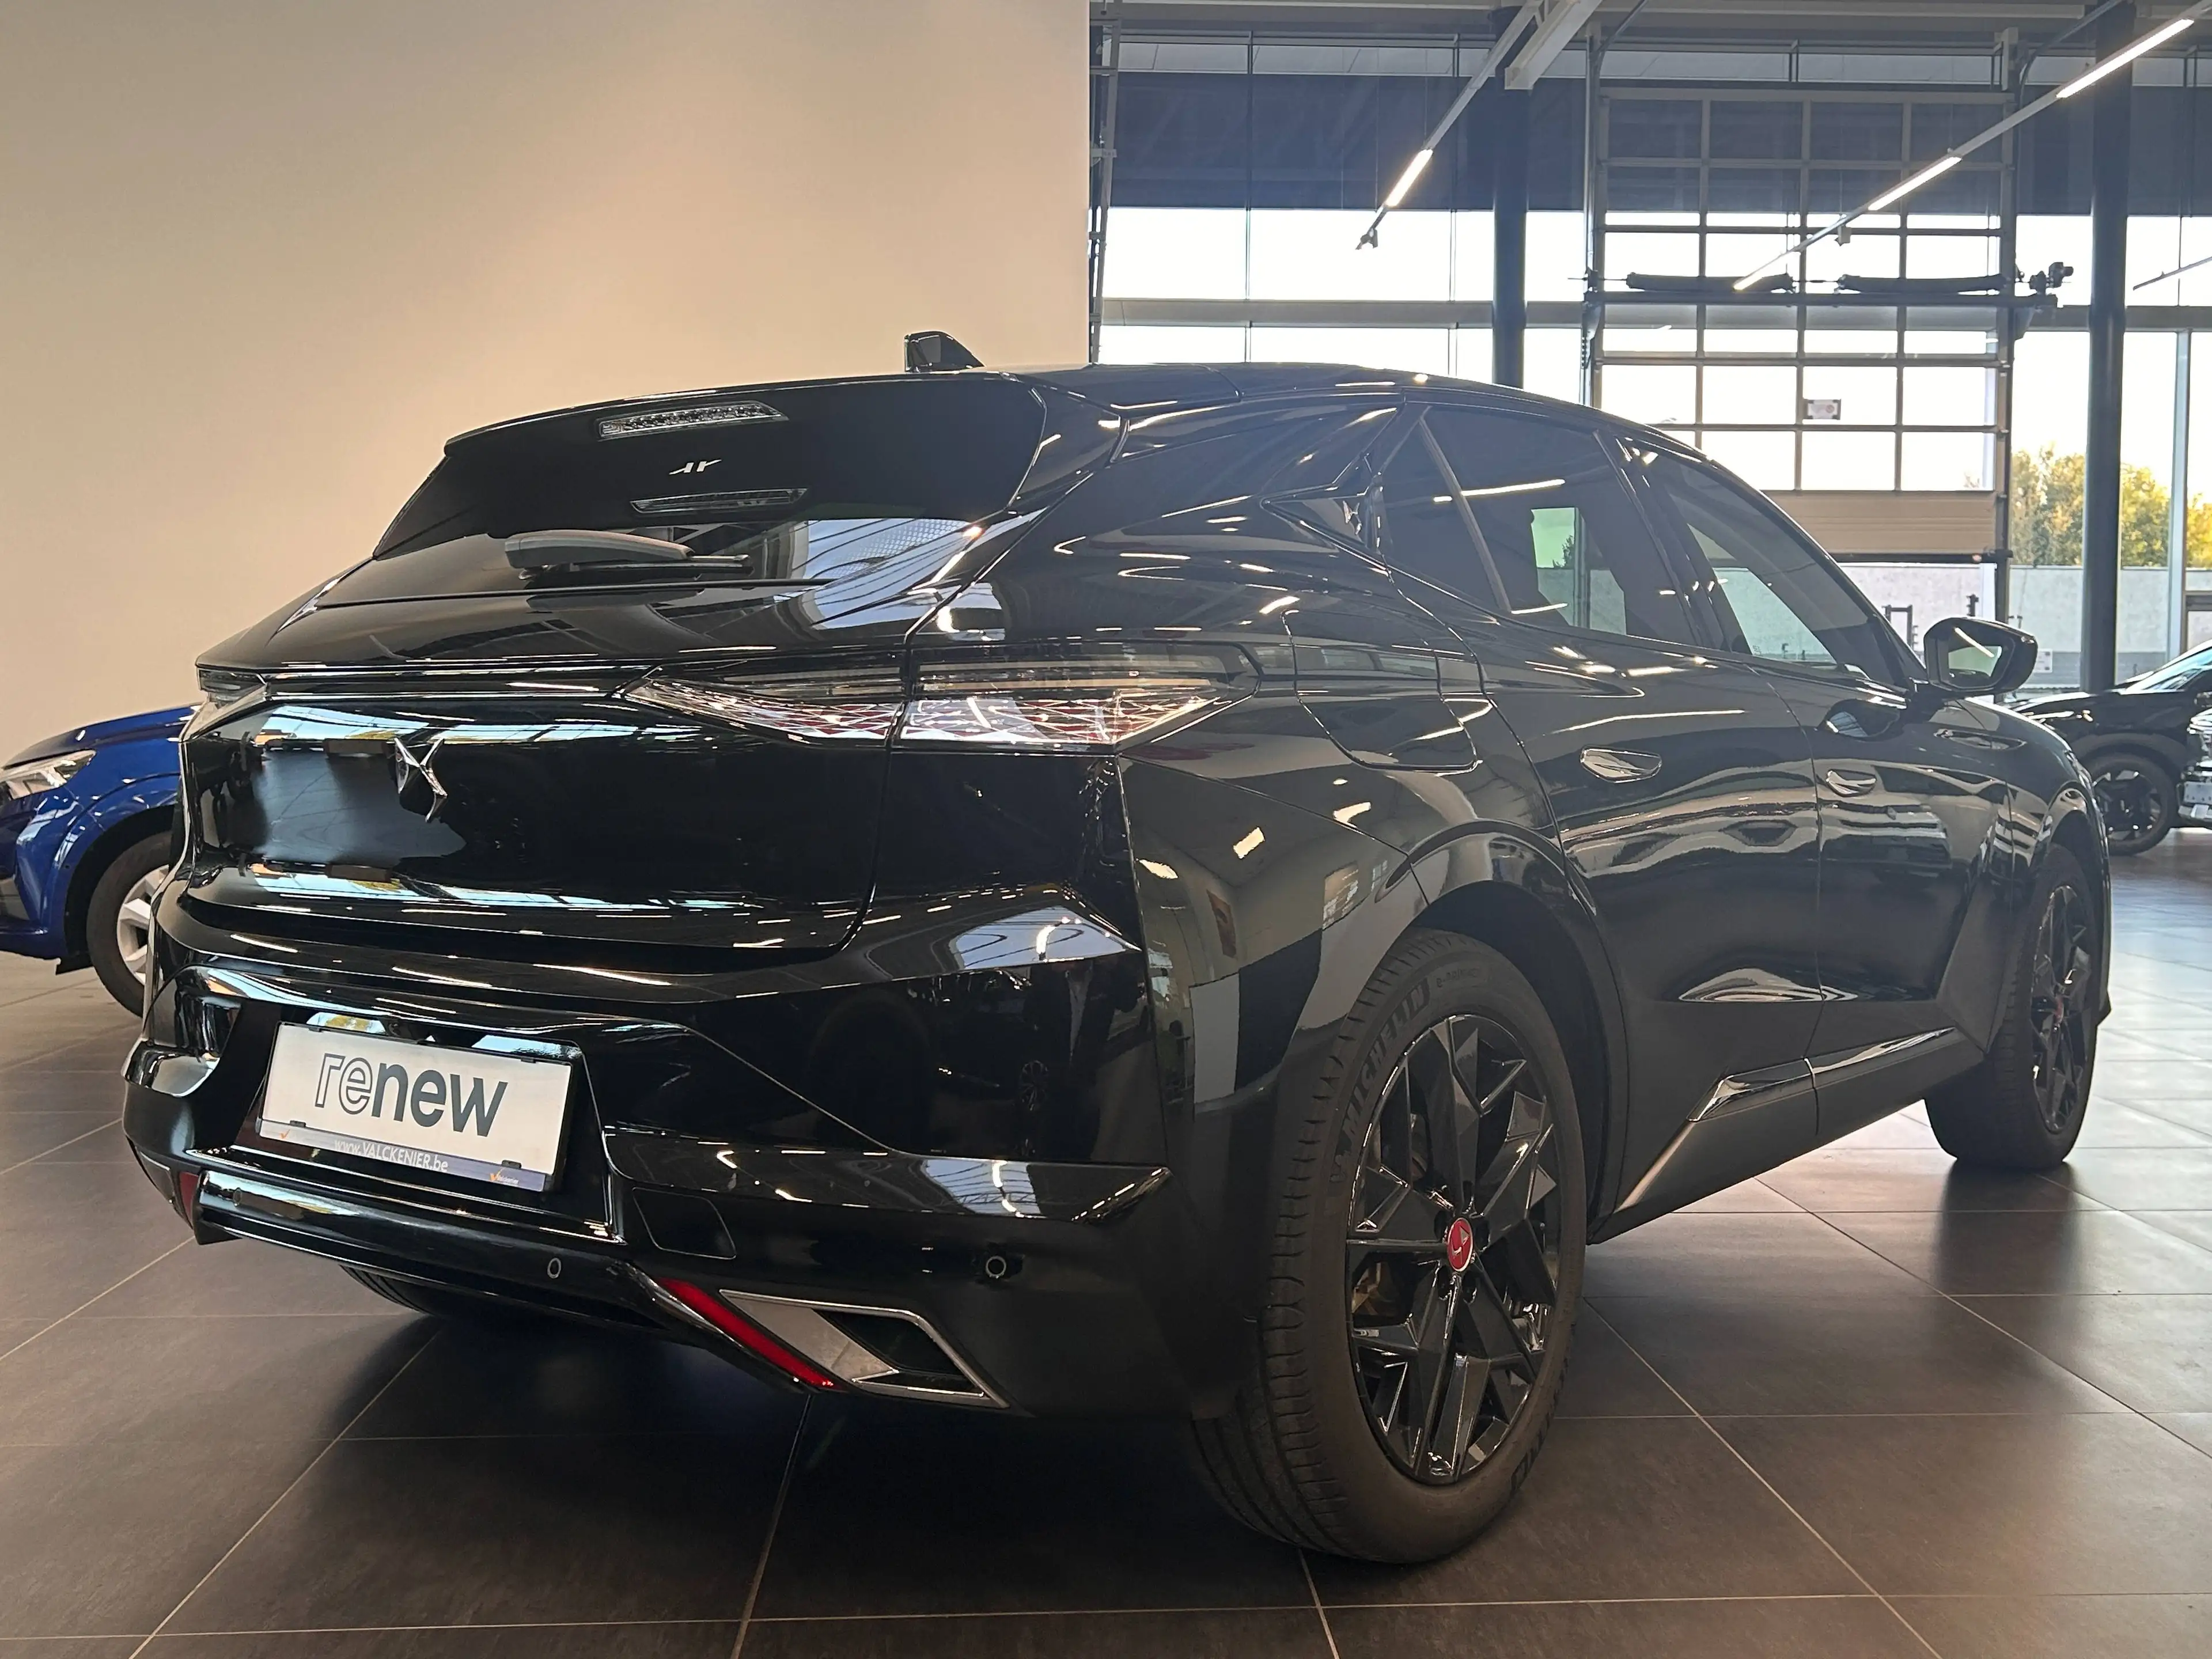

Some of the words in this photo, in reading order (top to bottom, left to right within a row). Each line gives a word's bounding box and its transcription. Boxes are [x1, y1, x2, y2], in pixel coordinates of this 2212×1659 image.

[315, 1053, 508, 1137] renew
[1343, 982, 1427, 1141] MICHELIN
[334, 1140, 448, 1172] www.VALCKENIER.be
